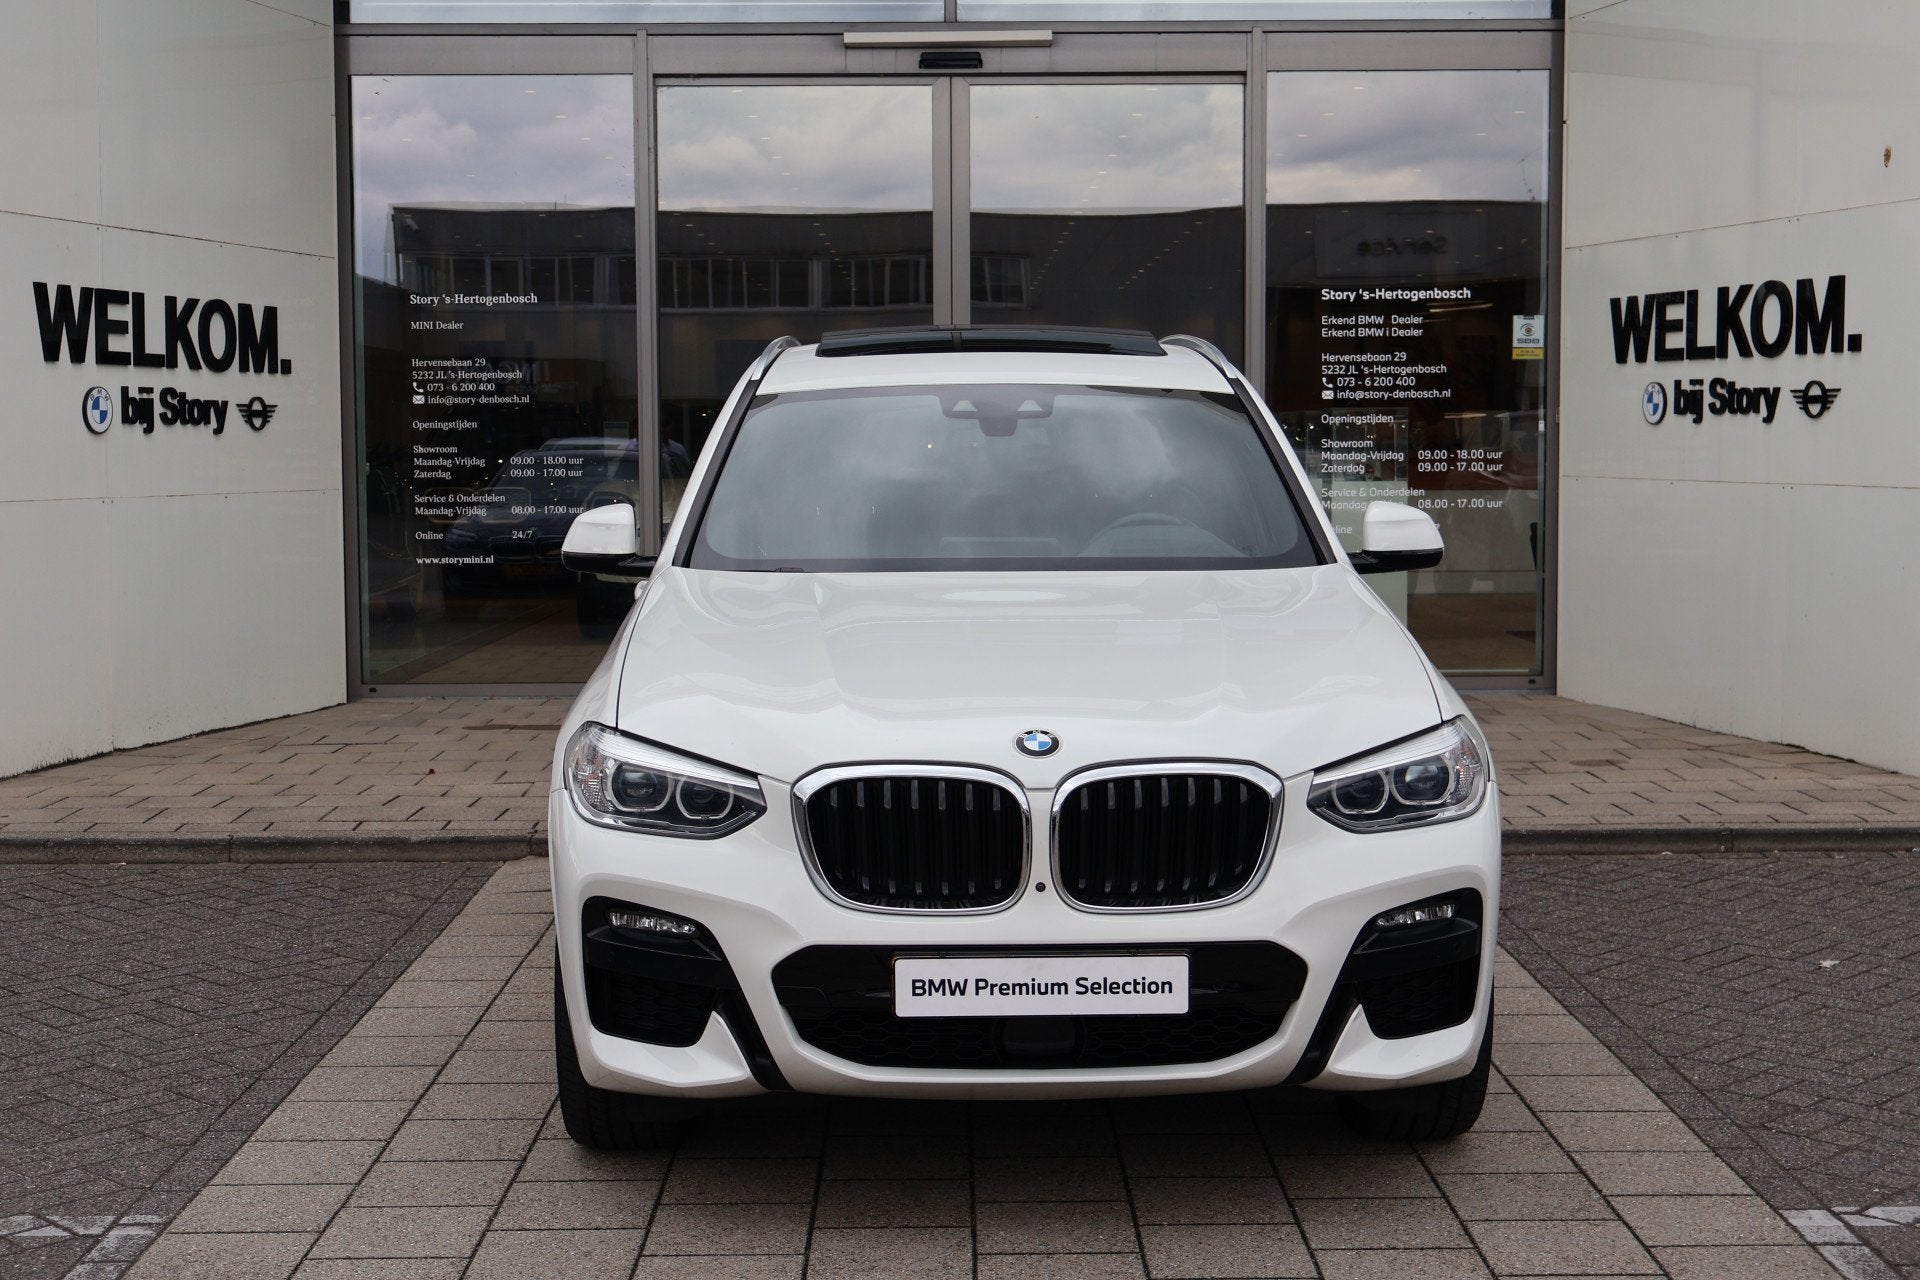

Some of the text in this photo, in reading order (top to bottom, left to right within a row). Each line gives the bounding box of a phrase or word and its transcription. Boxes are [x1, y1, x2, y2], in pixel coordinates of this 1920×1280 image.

[410, 294, 439, 306] Story
[1321, 289, 1357, 302] Story
[1321, 315, 1423, 325] Erkend BMW Dealer
[1610, 275, 1862, 364] WELKOM.
[33, 282, 292, 375] WELKOM.
[411, 321, 464, 330] MINI Dealer
[1321, 328, 1356, 338] Erkend
[1358, 328, 1384, 337] BMW
[1391, 327, 1423, 337] Dealer
[411, 358, 486, 367] Hervensebaan 29
[1321, 352, 1407, 362] Hervensebaan 29
[412, 371, 434, 380] 5232
[435, 371, 447, 380] JL
[1321, 365, 1346, 375] 5232
[1348, 365, 1359, 375] JL
[427, 383, 444, 392] 073
[451, 383, 458, 392] 6
[460, 383, 477, 391] 200
[478, 382, 495, 391] 400
[1337, 377, 1355, 387] 073
[1364, 377, 1371, 386] 6
[1373, 377, 1393, 386] 200
[1395, 376, 1416, 386] 400
[427, 395, 530, 406] info@story-denbosch.nl
[1337, 389, 1451, 401] info@story-denbosch.nl
[1708, 377, 1781, 424] Story
[159, 386, 229, 435] Story
[1321, 414, 1394, 425] Openingstijden
[412, 420, 478, 431] Openingstijden
[1321, 439, 1373, 448] Showroom
[413, 445, 458, 454] Showroom
[413, 457, 486, 467] Maandag-Vrijdag
[510, 457, 535, 465] 09.00
[543, 456, 567, 465] 18.00
[1321, 451, 1404, 462] Maandag-Vrijdag
[1418, 450, 1447, 459] 09.00
[1457, 450, 1484, 459] 18.00
[1321, 464, 1365, 474] Zaterdag
[1418, 462, 1447, 472] 09.00
[413, 470, 452, 480] Zaterdag
[510, 469, 535, 477] 09.00
[543, 469, 566, 477] 17.00
[1321, 487, 1425, 497] Service & Onderdelen
[414, 494, 447, 503] Service
[457, 494, 505, 502] Onderdelen
[1418, 500, 1447, 509] 08.00
[415, 506, 487, 517] Maandag-Vrijdag
[511, 506, 536, 514] 08.00
[543, 505, 567, 514] 17.00
[415, 530, 533, 540] Online 24/7
[1331, 525, 1352, 534] line
[416, 555, 494, 565] www.storymini.nl
[911, 976, 1173, 996] BMW Premium Selection
